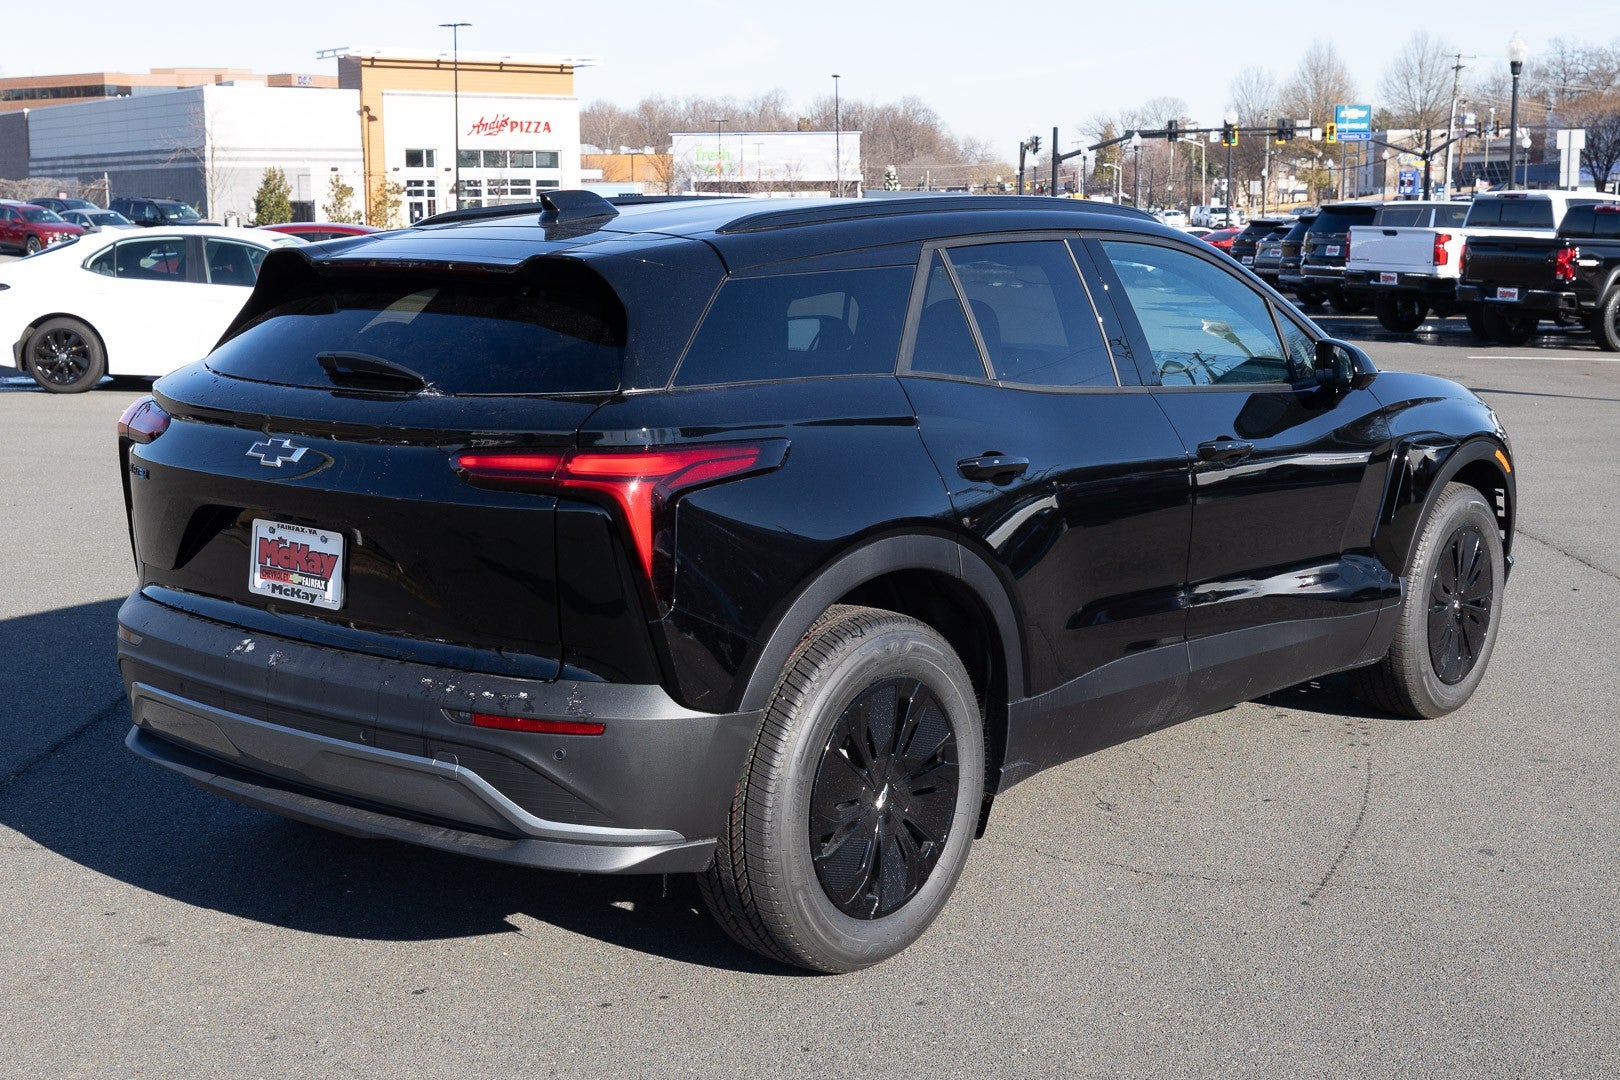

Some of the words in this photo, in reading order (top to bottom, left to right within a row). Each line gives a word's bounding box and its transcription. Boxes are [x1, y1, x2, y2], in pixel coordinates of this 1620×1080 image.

[510, 121, 551, 133] PIZZA
[696, 148, 731, 161] freh
[258, 537, 339, 582] McKay
[261, 568, 290, 581] CHEVROLET
[302, 576, 326, 590] FAIRFAX
[271, 583, 318, 604] McKay
